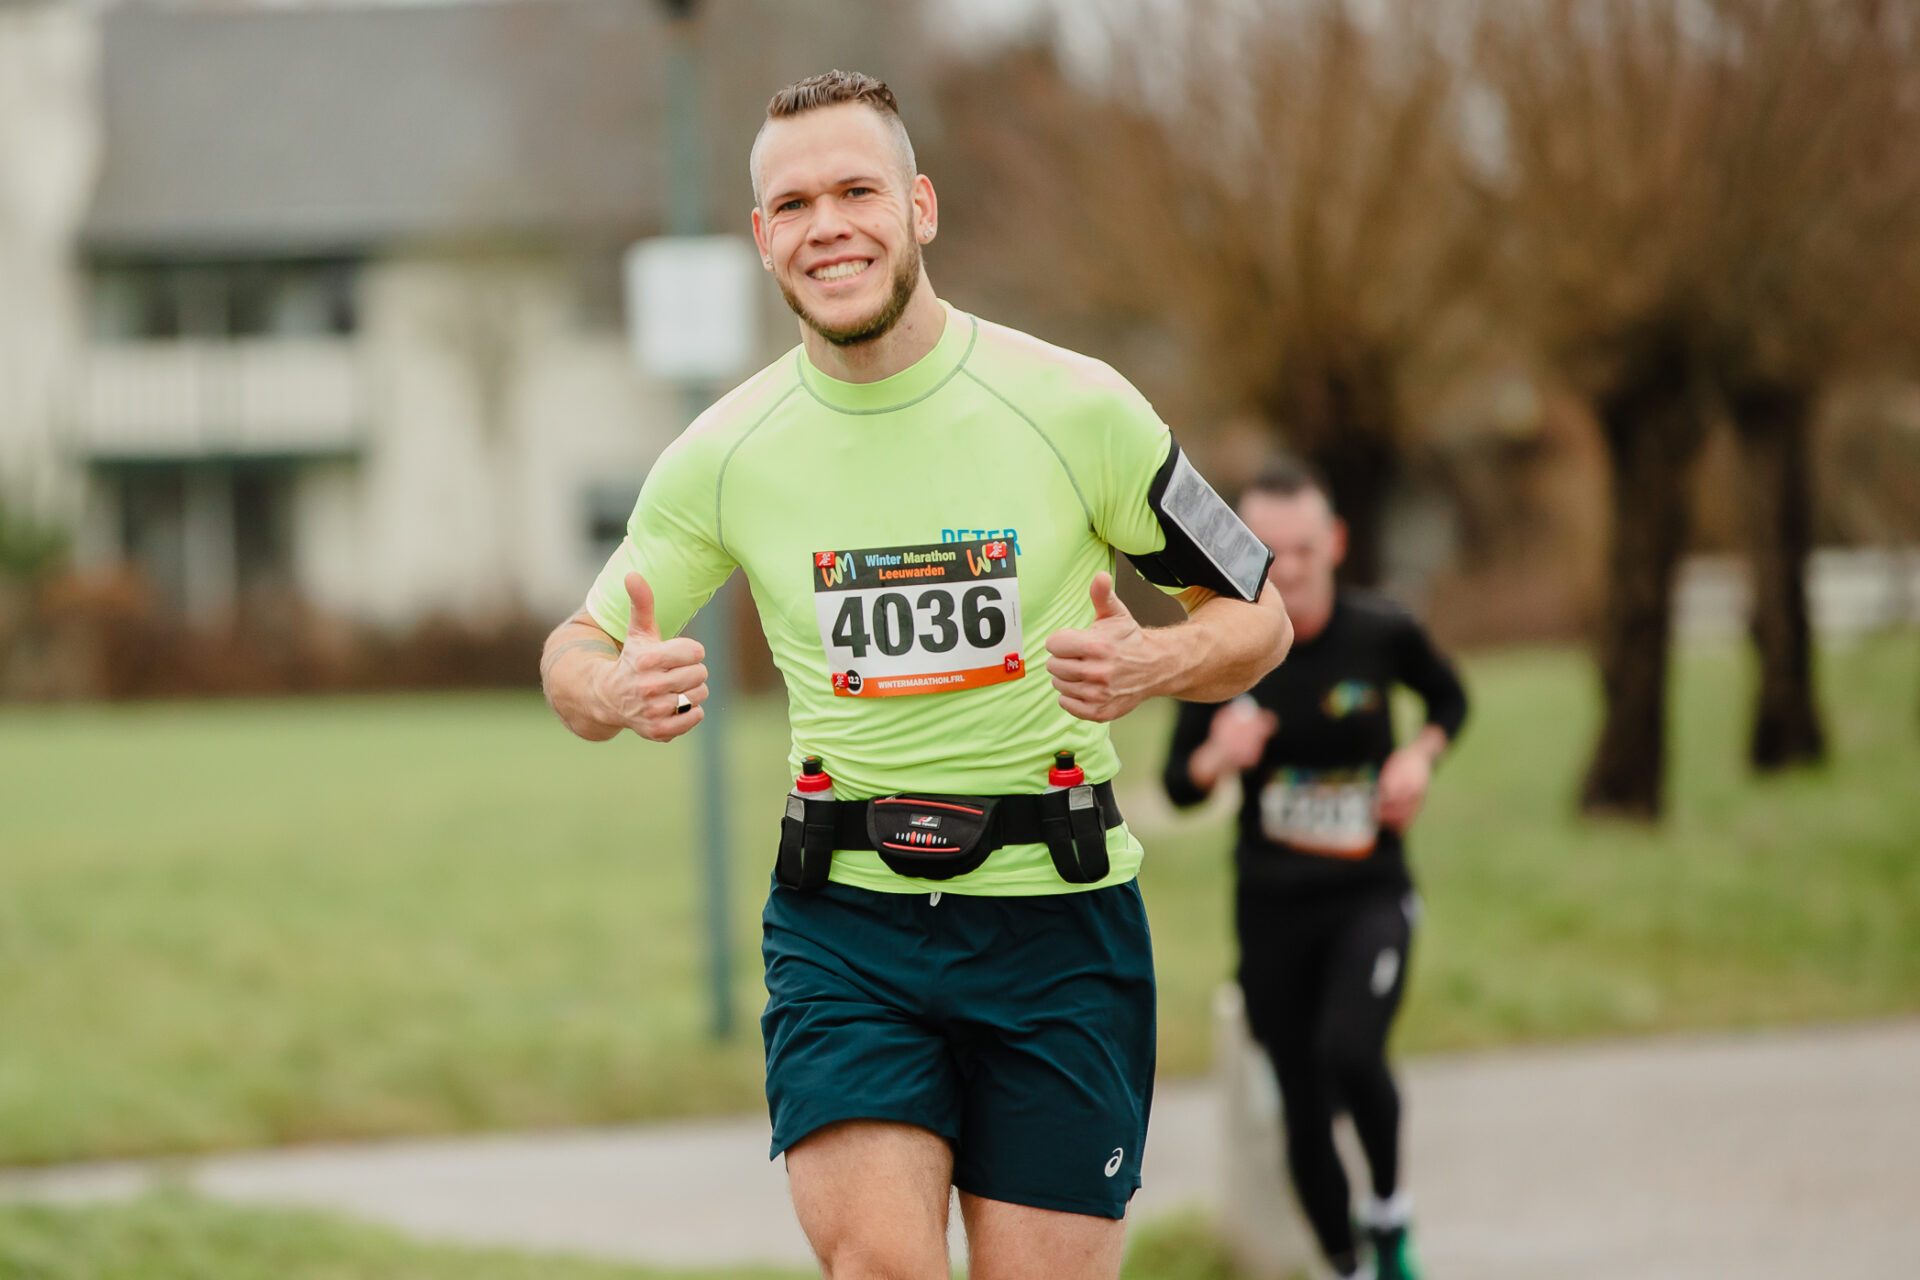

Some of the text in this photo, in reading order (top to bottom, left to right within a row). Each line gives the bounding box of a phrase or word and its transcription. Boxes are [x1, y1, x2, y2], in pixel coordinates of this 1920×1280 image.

[865, 550, 957, 567] Winter Marathon
[878, 564, 946, 581] Leeuwarden
[832, 585, 1006, 658] 4036
[878, 674, 966, 690] WINTERMARATHON.FRL
